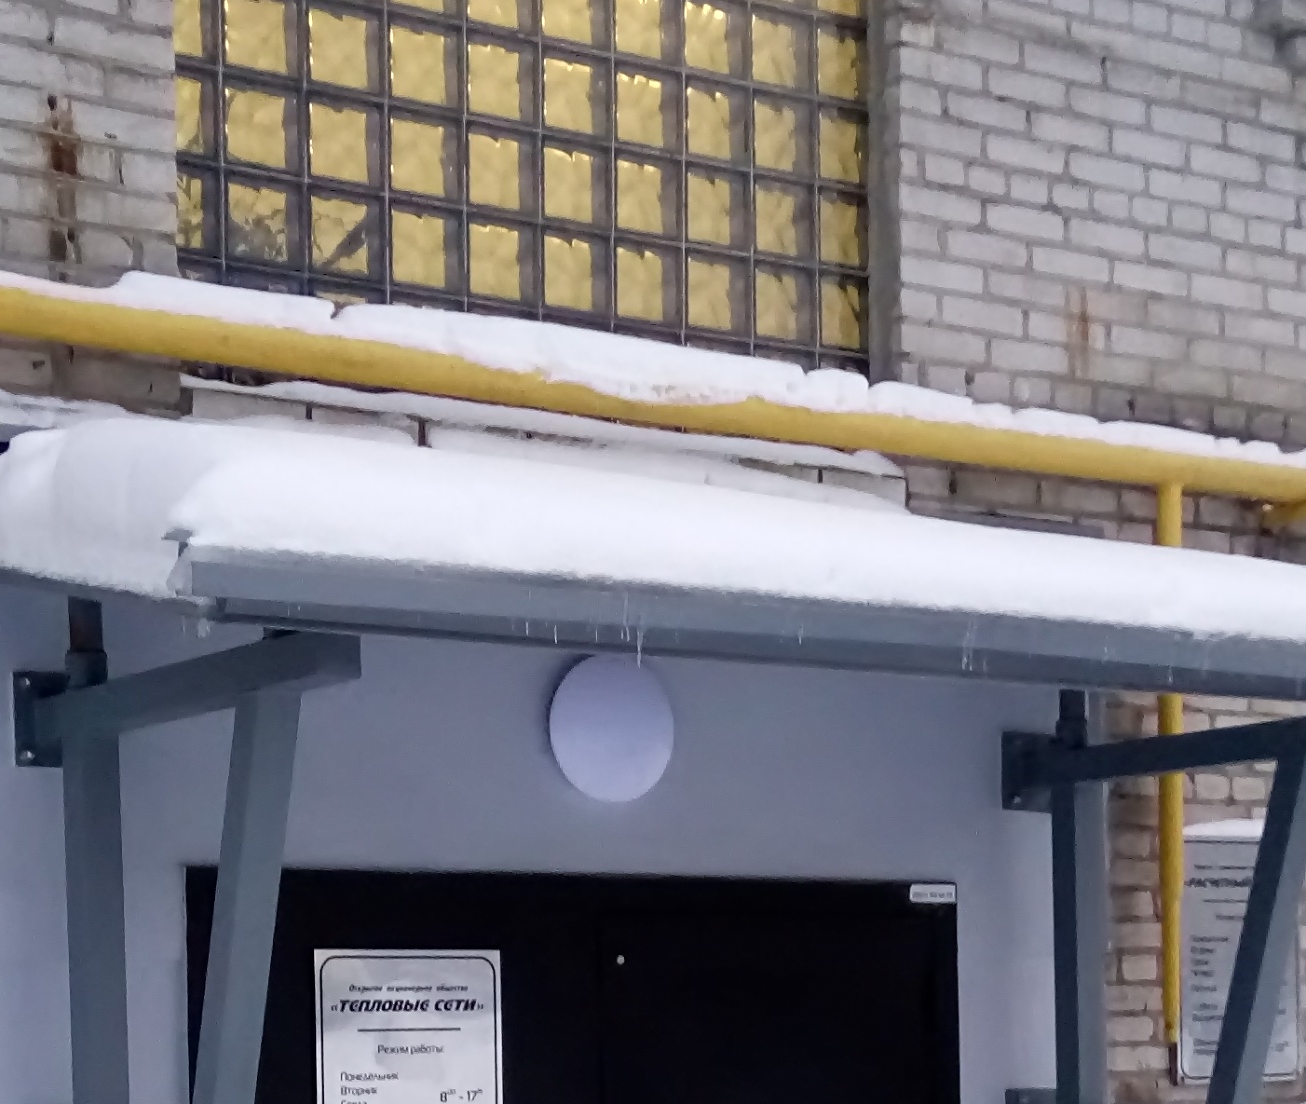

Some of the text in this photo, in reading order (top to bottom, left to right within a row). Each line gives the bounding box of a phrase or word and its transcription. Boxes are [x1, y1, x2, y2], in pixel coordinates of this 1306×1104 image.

[377, 1044, 408, 1054] Режим
[340, 1071, 399, 1082] Понедельник
[340, 1086, 377, 1096] Вторник
